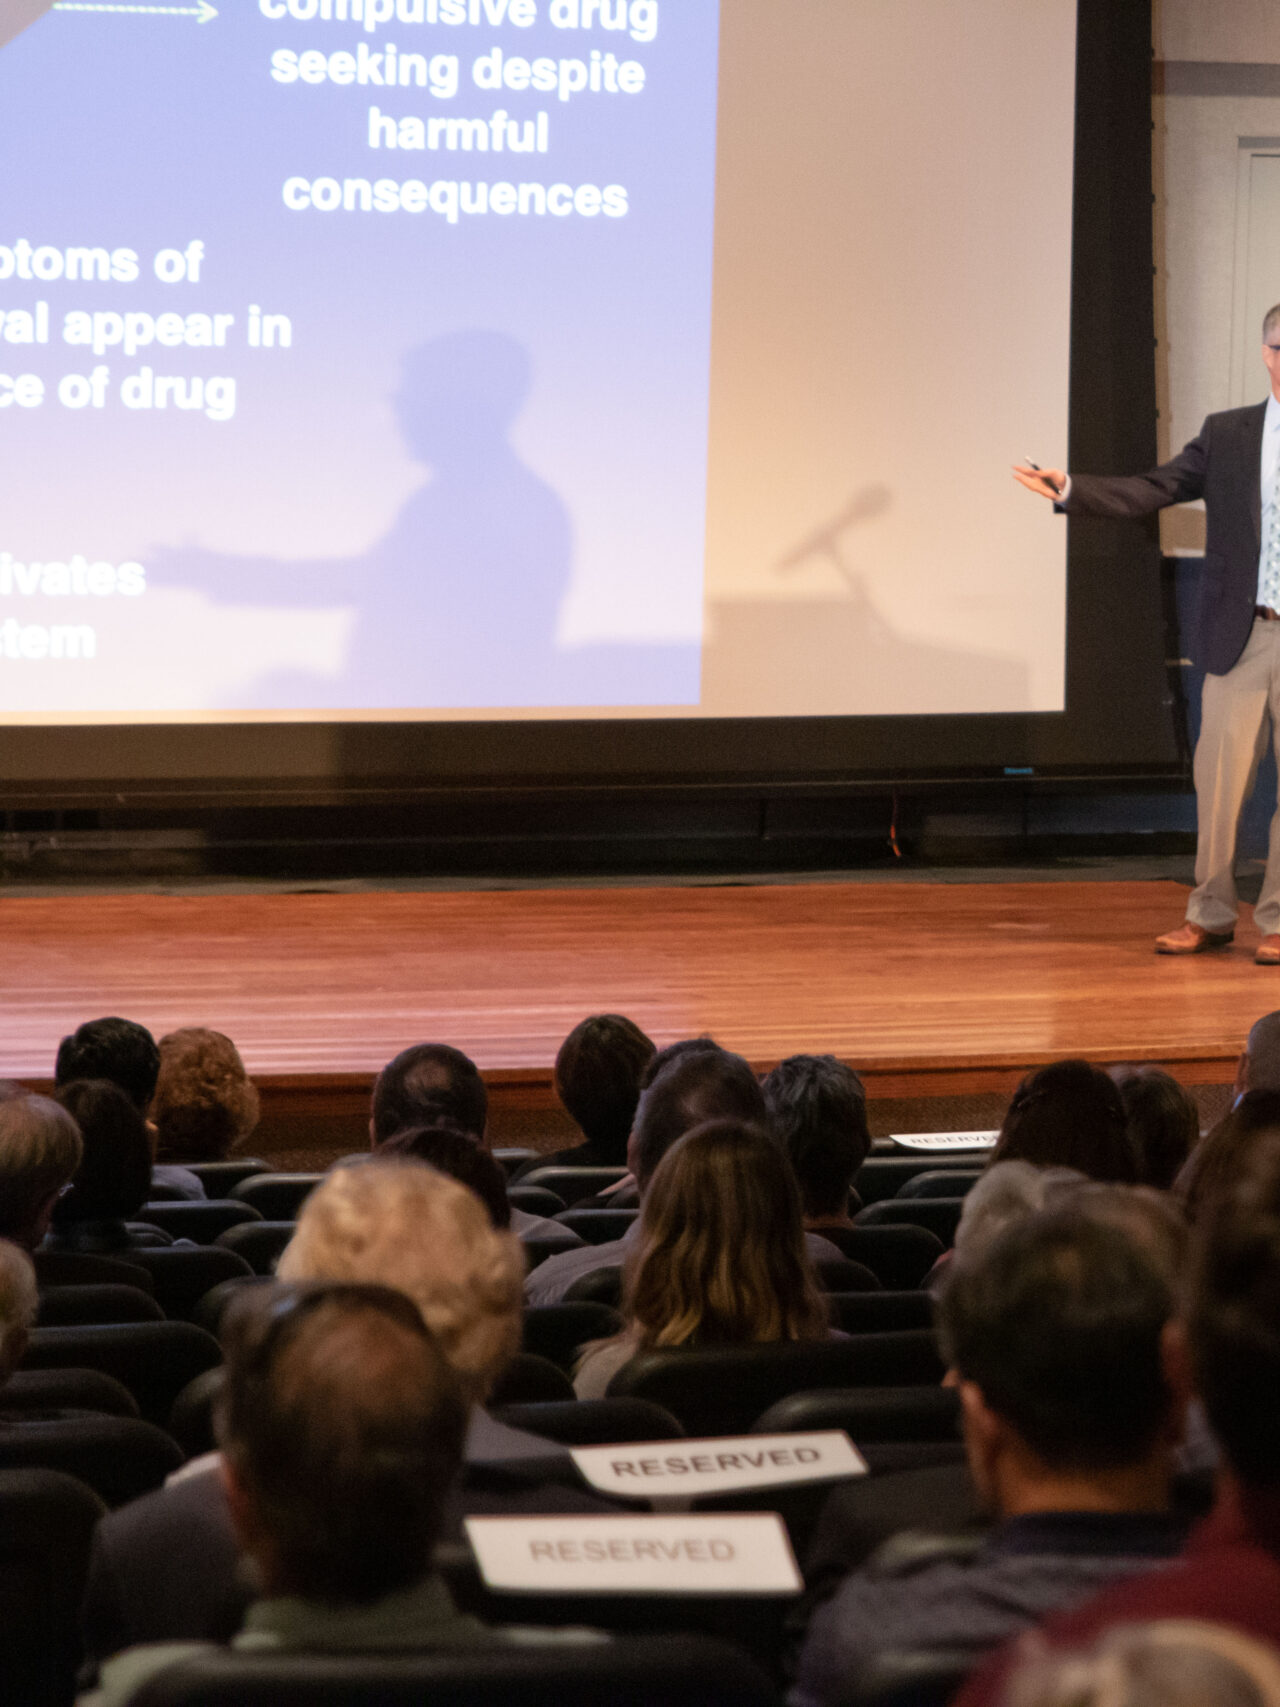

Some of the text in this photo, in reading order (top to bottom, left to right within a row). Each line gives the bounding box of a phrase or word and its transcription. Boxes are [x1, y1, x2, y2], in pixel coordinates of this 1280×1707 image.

[258, 0, 659, 42] compulsive drug
[270, 42, 646, 102] seeking despite
[368, 106, 549, 153] harmful
[282, 176, 629, 224] consequences
[154, 239, 205, 283] of
[0, 300, 292, 355] al appear in
[58, 365, 110, 409] of
[120, 366, 236, 421] drug
[610, 1447, 821, 1478] RESERVED
[528, 1539, 735, 1563] RESERVED
